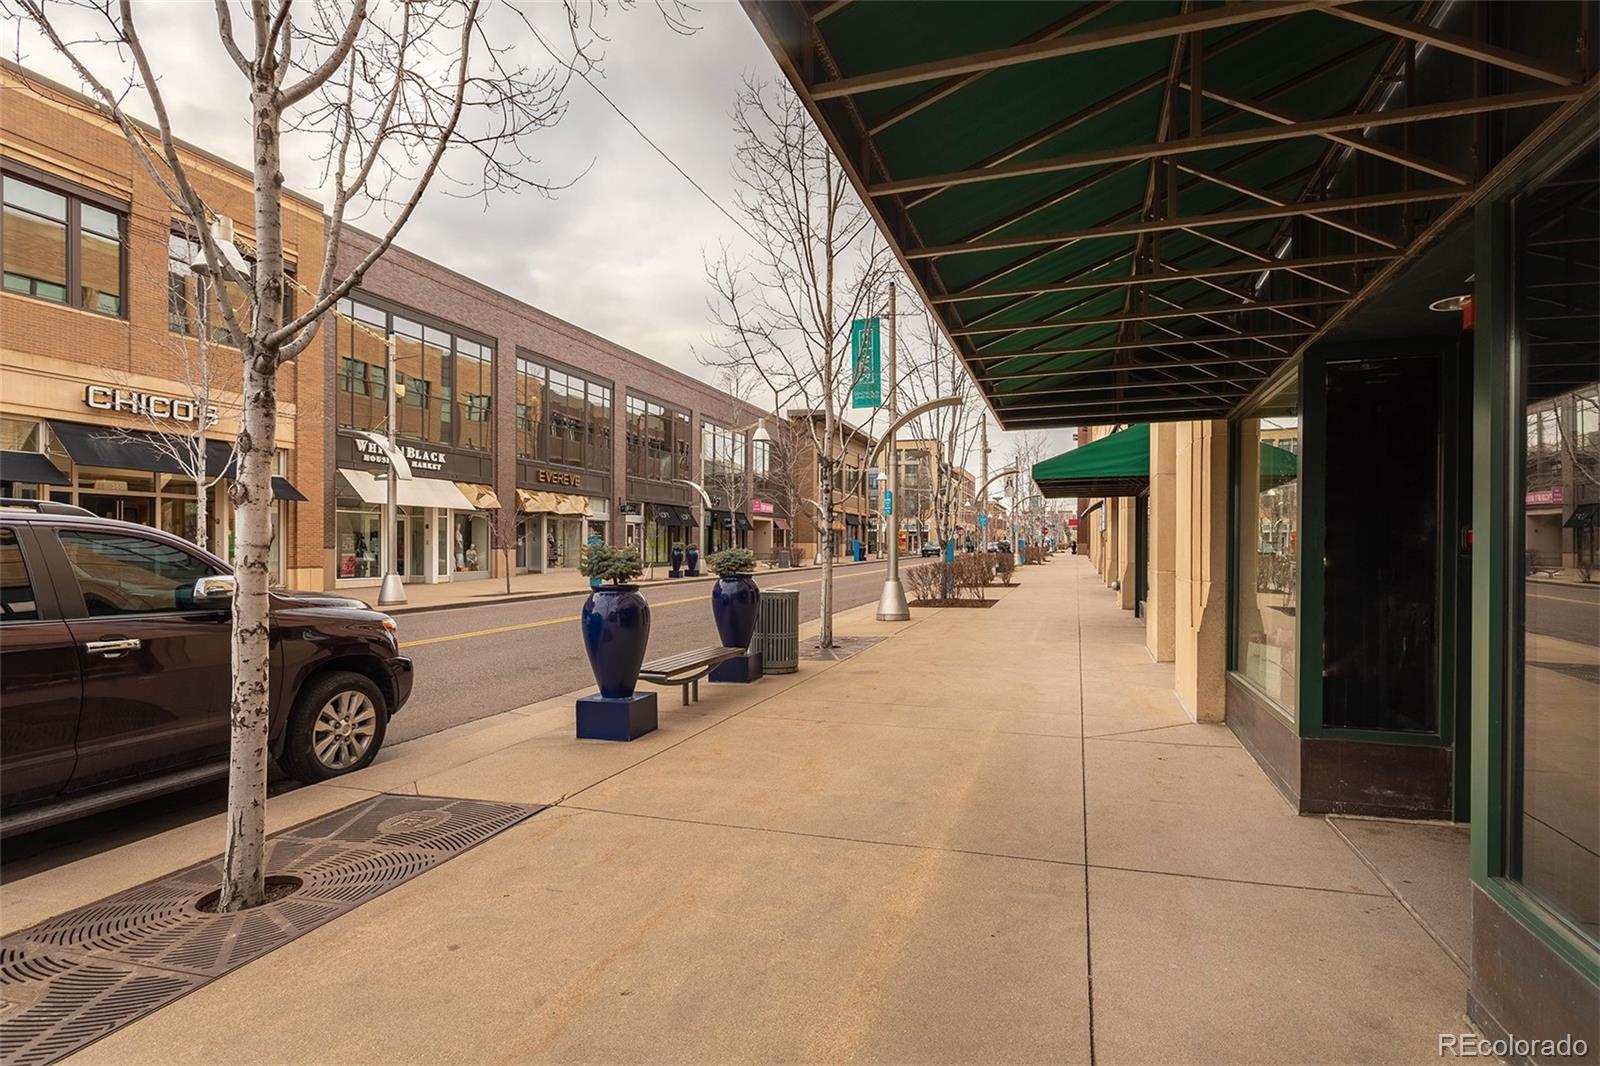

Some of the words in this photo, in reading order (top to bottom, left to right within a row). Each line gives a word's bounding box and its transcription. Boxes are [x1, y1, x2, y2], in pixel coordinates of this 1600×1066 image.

[406, 446, 446, 463] BLACK
[411, 461, 442, 471] MARKET
[539, 469, 581, 486] EVEREVE
